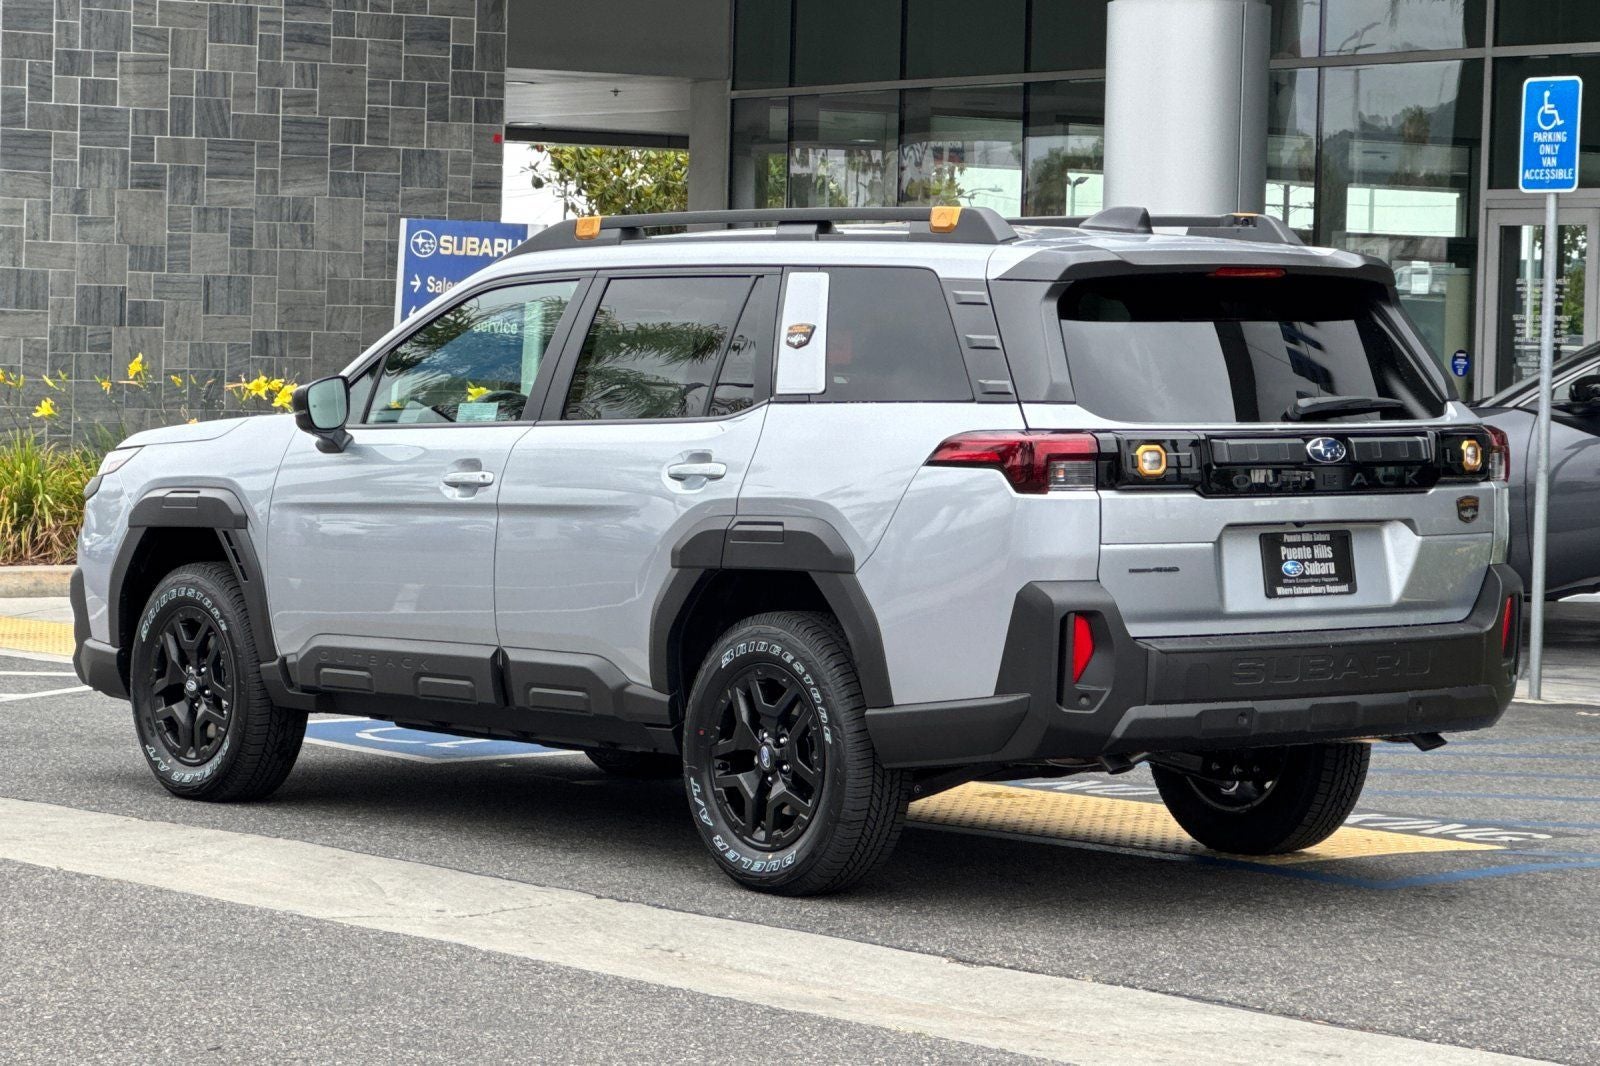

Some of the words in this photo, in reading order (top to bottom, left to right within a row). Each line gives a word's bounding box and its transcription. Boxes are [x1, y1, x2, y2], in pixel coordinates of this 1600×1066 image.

[1533, 131, 1568, 143] PARKING
[1539, 144, 1560, 155] ONLY
[1541, 156, 1557, 167] VAN
[1524, 168, 1574, 180] ACCESSIBLE
[1281, 545, 1312, 560] Puente
[1313, 544, 1333, 559] Hills
[1304, 561, 1336, 575] Subaru
[140, 586, 228, 642] BRIDGESTONE
[319, 650, 430, 671] OUTBACK
[1231, 651, 1432, 685] SUBARU
[721, 640, 832, 744] BRIDGESTONE
[690, 776, 714, 827] A/T
[712, 834, 797, 873] DUELER
